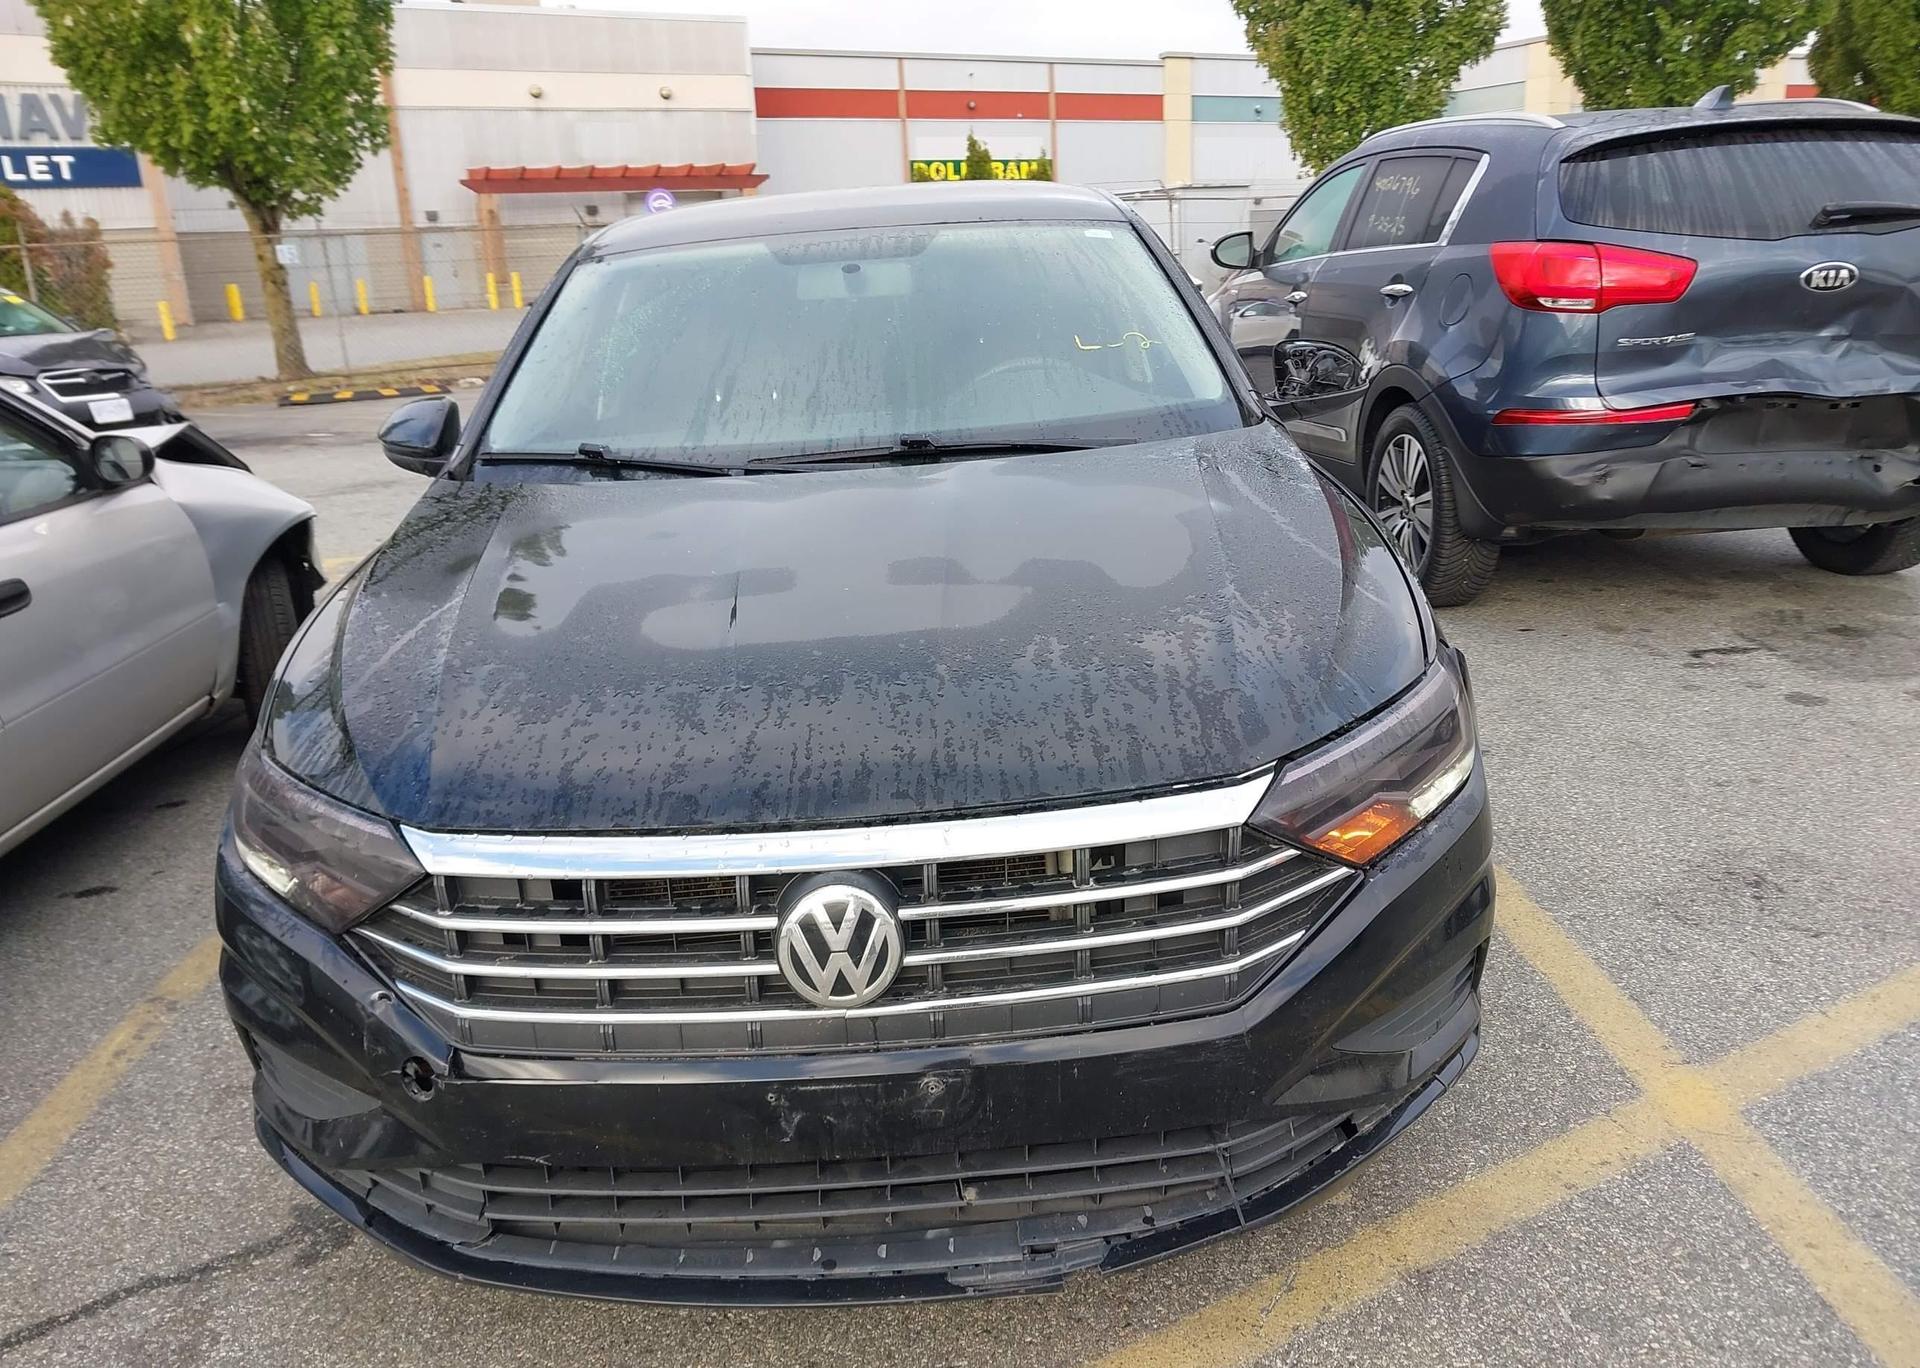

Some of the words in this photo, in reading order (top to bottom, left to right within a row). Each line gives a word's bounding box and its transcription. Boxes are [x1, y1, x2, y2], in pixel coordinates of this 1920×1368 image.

[0, 155, 76, 181] LET
[1810, 268, 1850, 288] KIA
[777, 884, 901, 1008] VW
